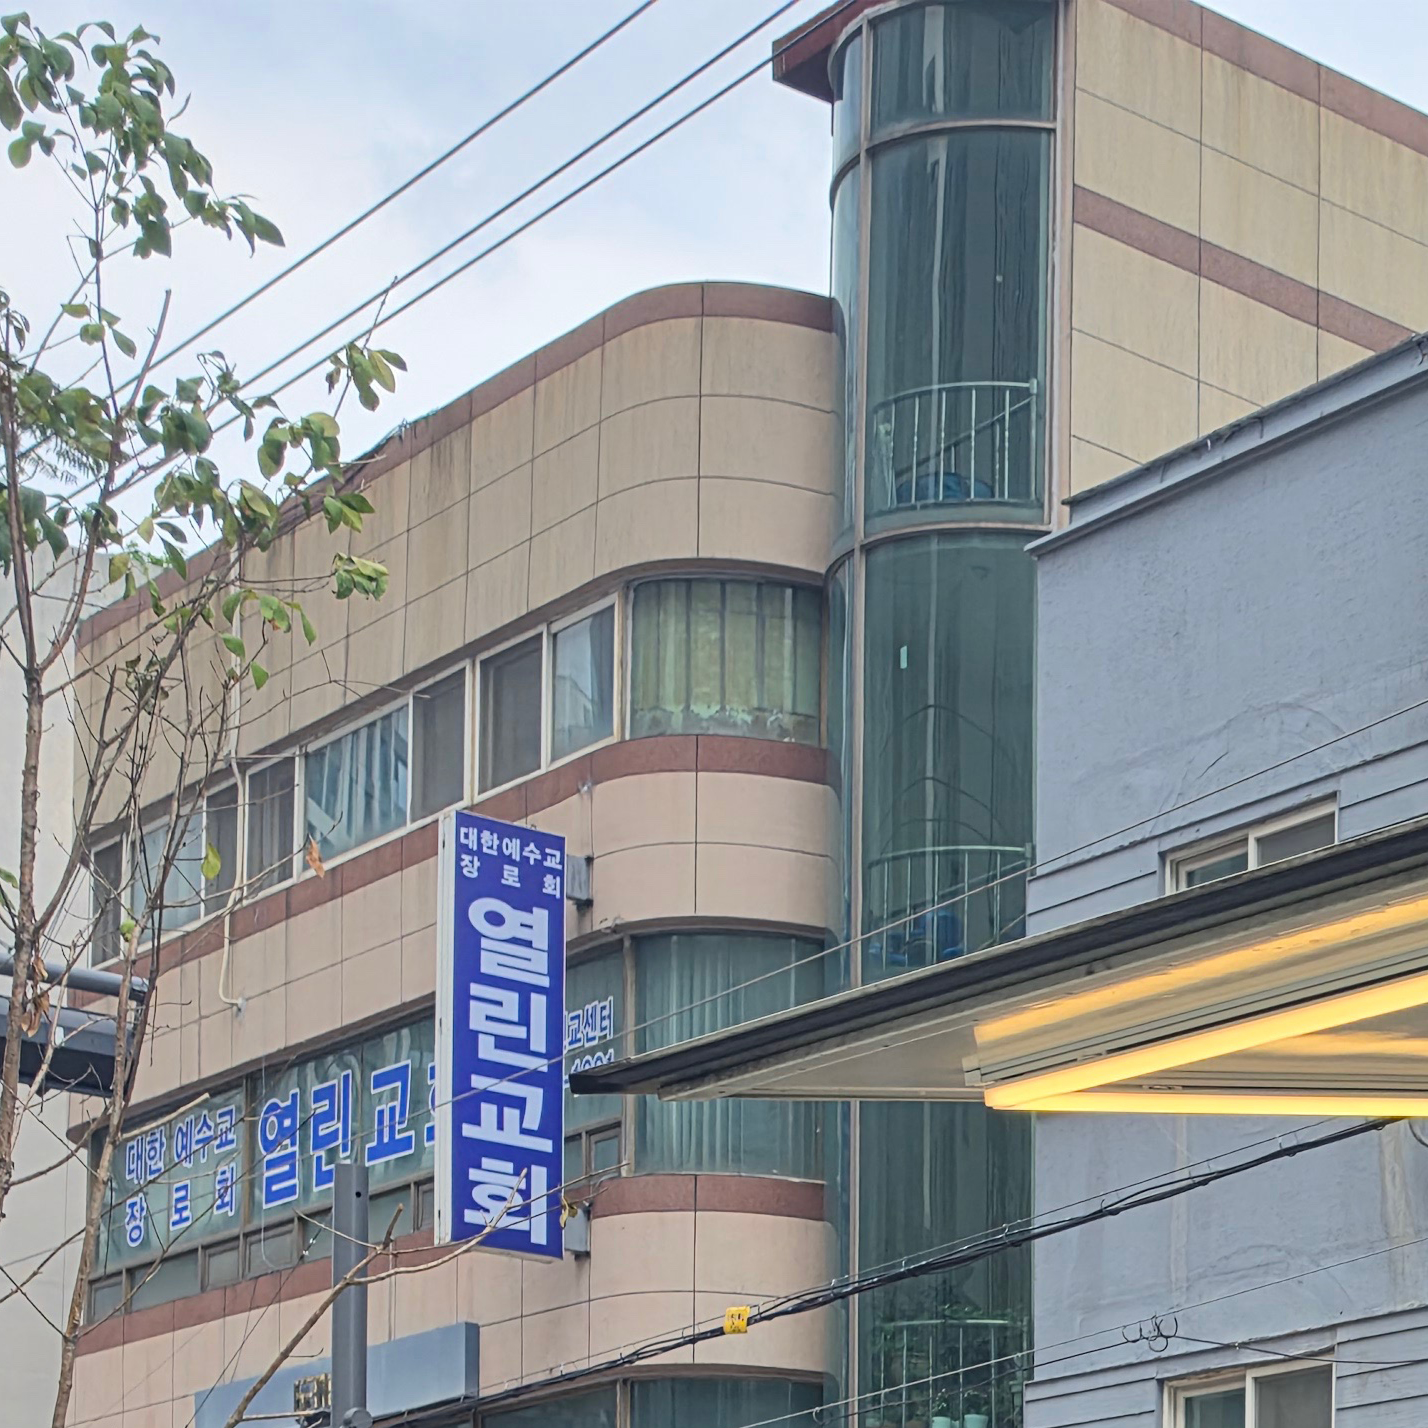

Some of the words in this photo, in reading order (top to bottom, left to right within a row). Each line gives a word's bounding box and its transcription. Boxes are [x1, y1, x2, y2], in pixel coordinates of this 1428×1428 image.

[460, 827, 563, 871] 대한예수교
[462, 897, 553, 1246] 열린교회
[565, 996, 613, 1054] 교센터
[259, 1059, 435, 1209] 열린교
